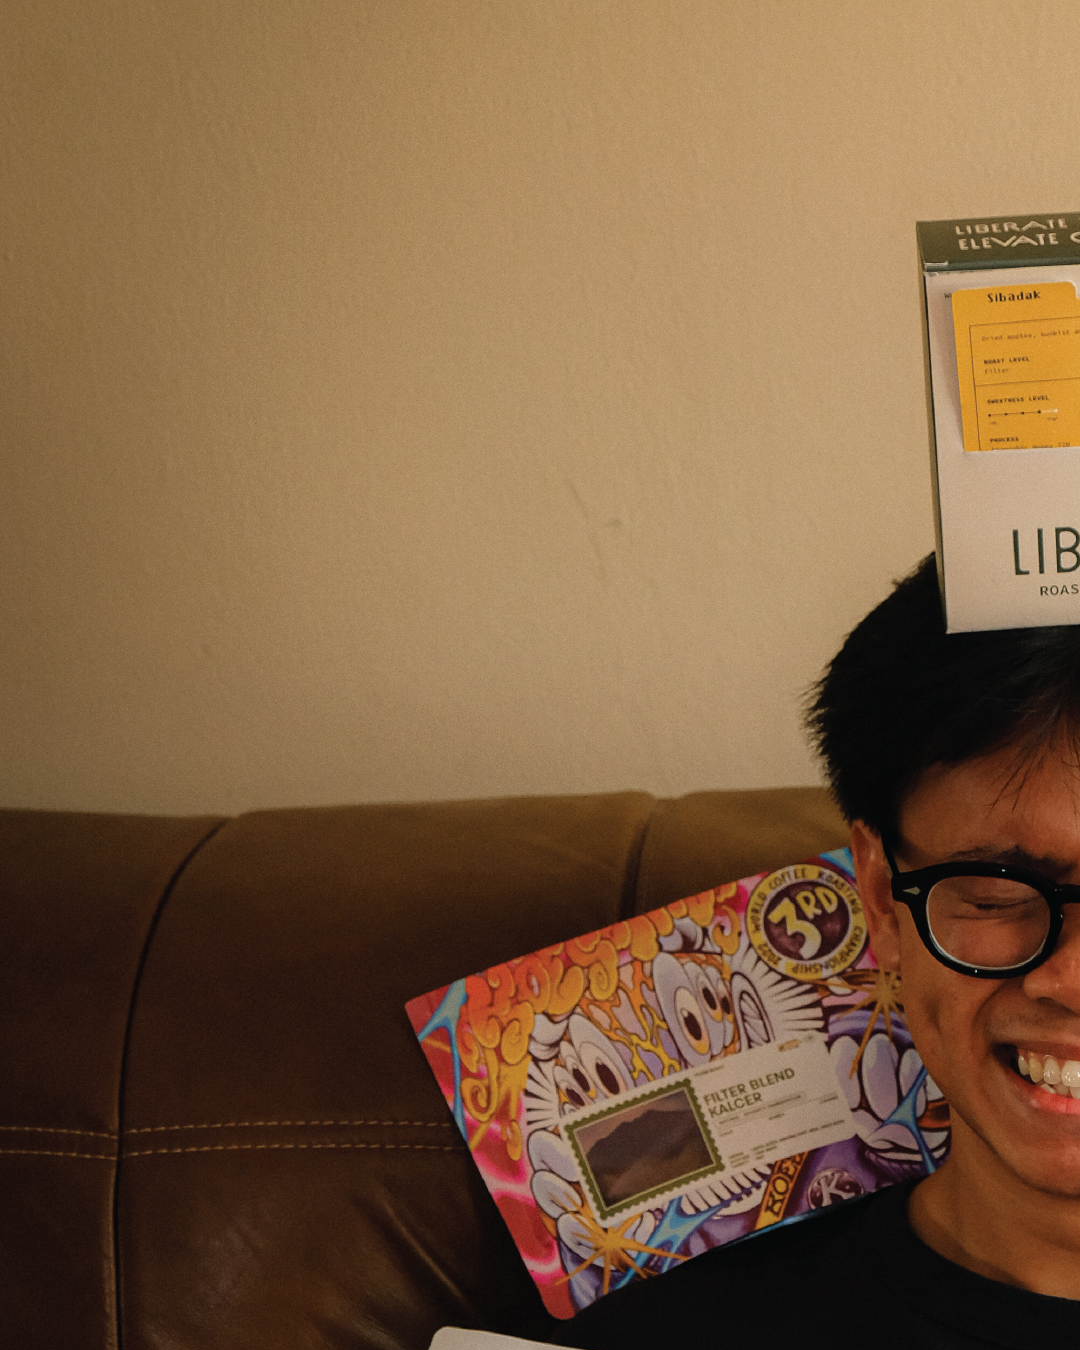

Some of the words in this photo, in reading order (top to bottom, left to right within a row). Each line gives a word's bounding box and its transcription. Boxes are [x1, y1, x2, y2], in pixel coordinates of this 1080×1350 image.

[955, 217, 1068, 236] LIBERATE
[959, 232, 1059, 250] ELEVATE
[986, 290, 1041, 304] Sibadak
[983, 357, 1005, 365] ROAST
[1029, 394, 1049, 402] LEVEL
[767, 885, 838, 960] 3RD
[702, 1082, 746, 1107] FILTER
[749, 1067, 795, 1090] BLEND
[709, 1091, 762, 1118] KALCER
